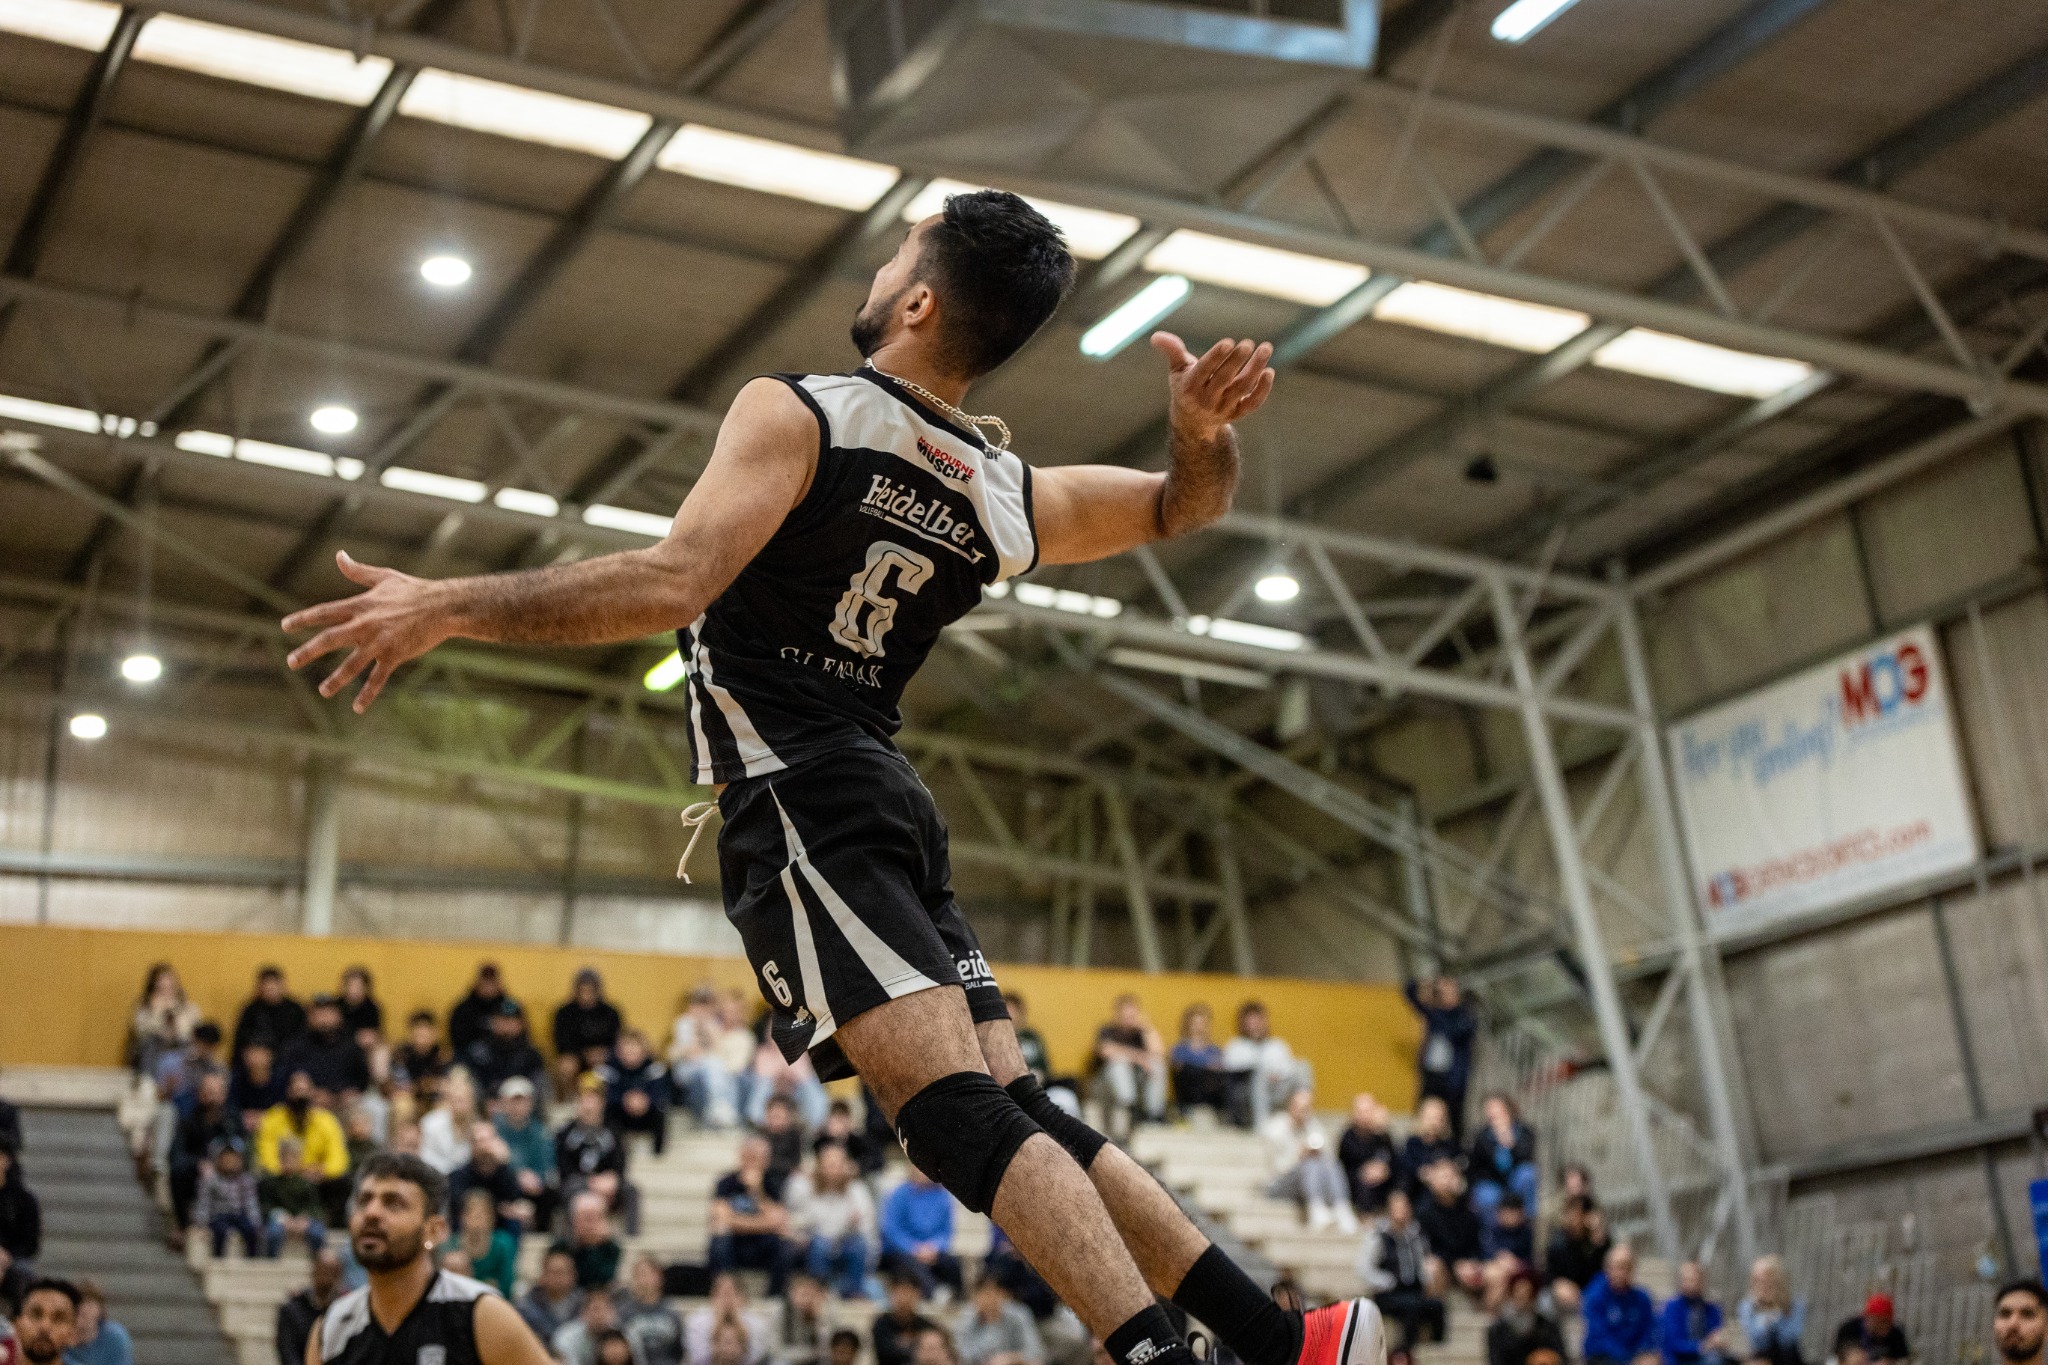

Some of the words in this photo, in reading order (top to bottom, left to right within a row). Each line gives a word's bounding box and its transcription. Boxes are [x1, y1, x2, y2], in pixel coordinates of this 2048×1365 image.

[917, 441, 970, 484] MUSCLE
[918, 436, 975, 479] MELBOURNE
[828, 540, 935, 660] 6
[762, 960, 793, 1008] 6
[951, 949, 995, 981] eid
